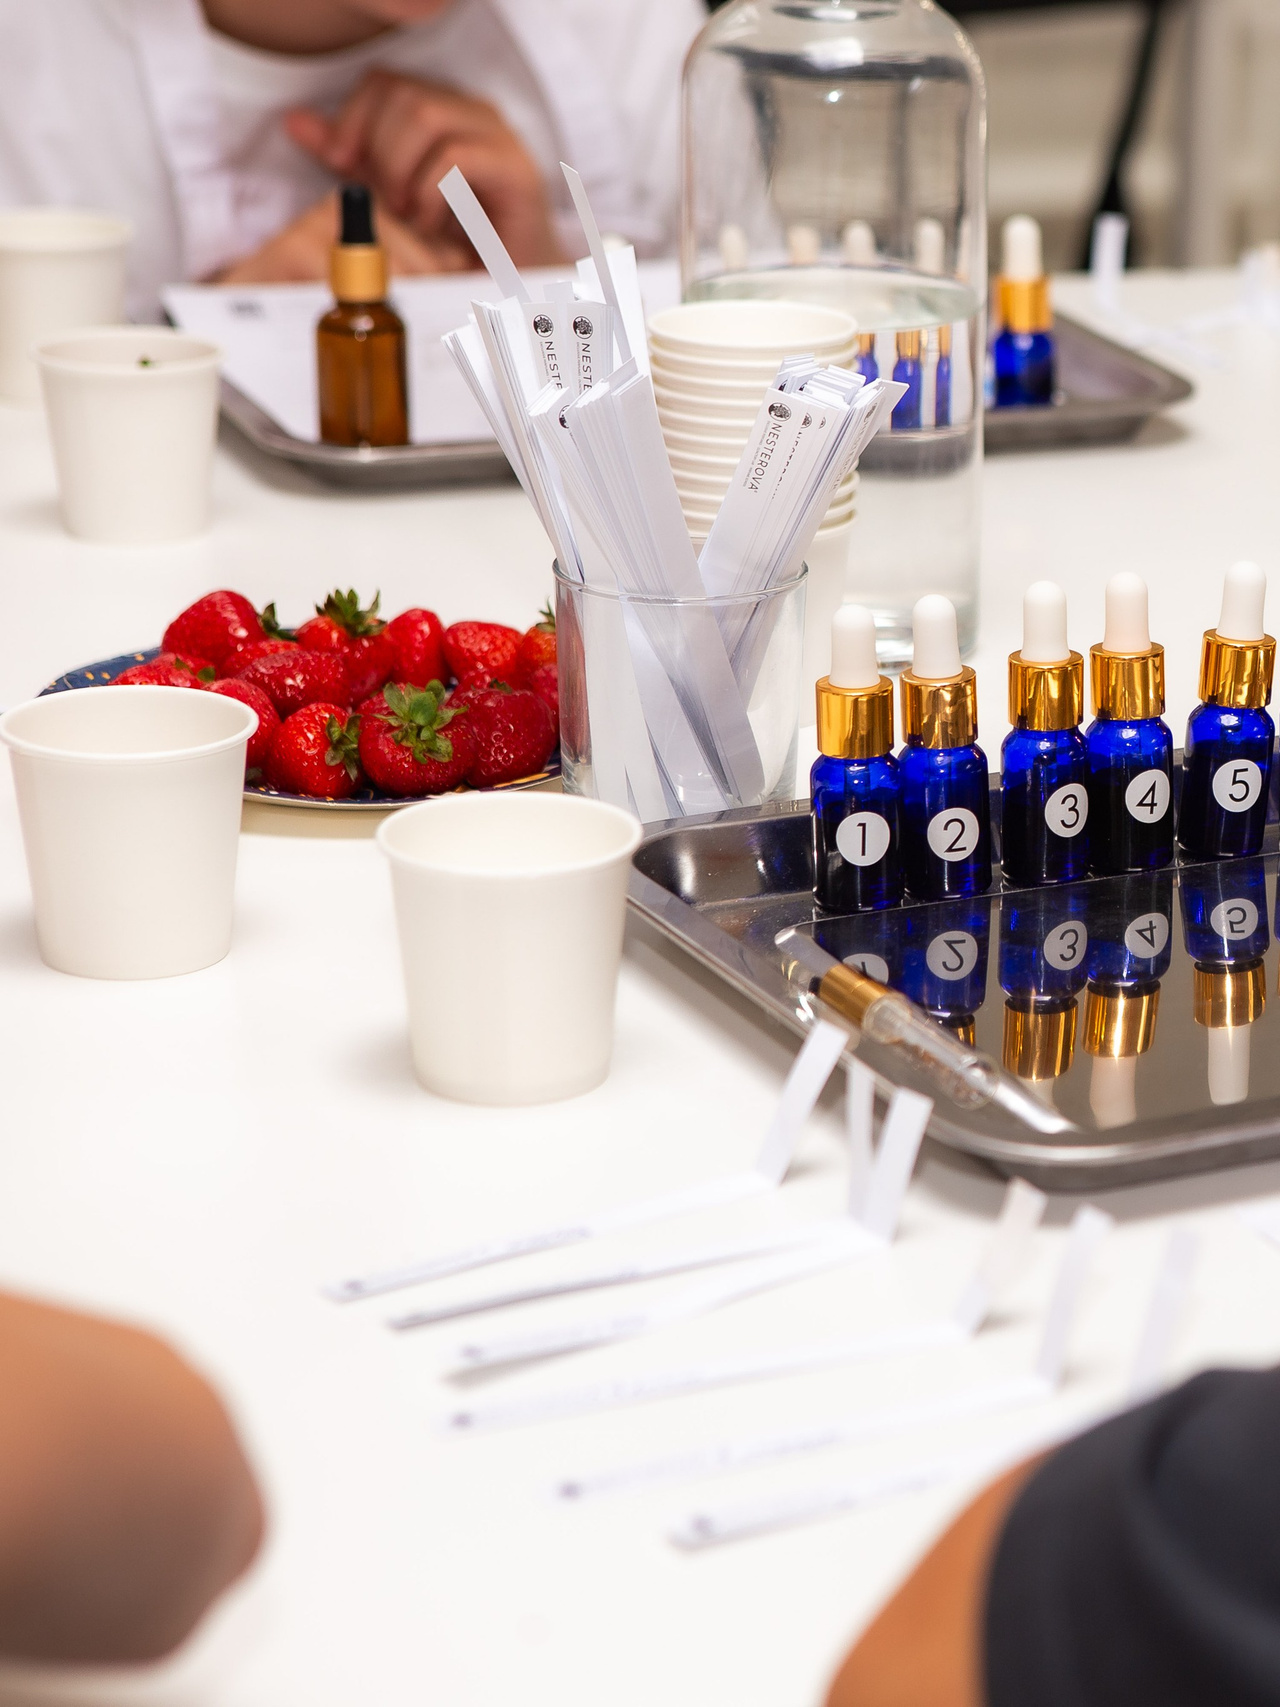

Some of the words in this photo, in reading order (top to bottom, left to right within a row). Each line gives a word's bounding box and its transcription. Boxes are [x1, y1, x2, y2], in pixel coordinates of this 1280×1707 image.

[748, 422, 783, 491] NESTEROVA
[1135, 779, 1158, 815] 4
[1228, 767, 1250, 803] 5
[1060, 793, 1080, 829] 3
[856, 822, 867, 857] 1
[943, 818, 967, 854] 2
